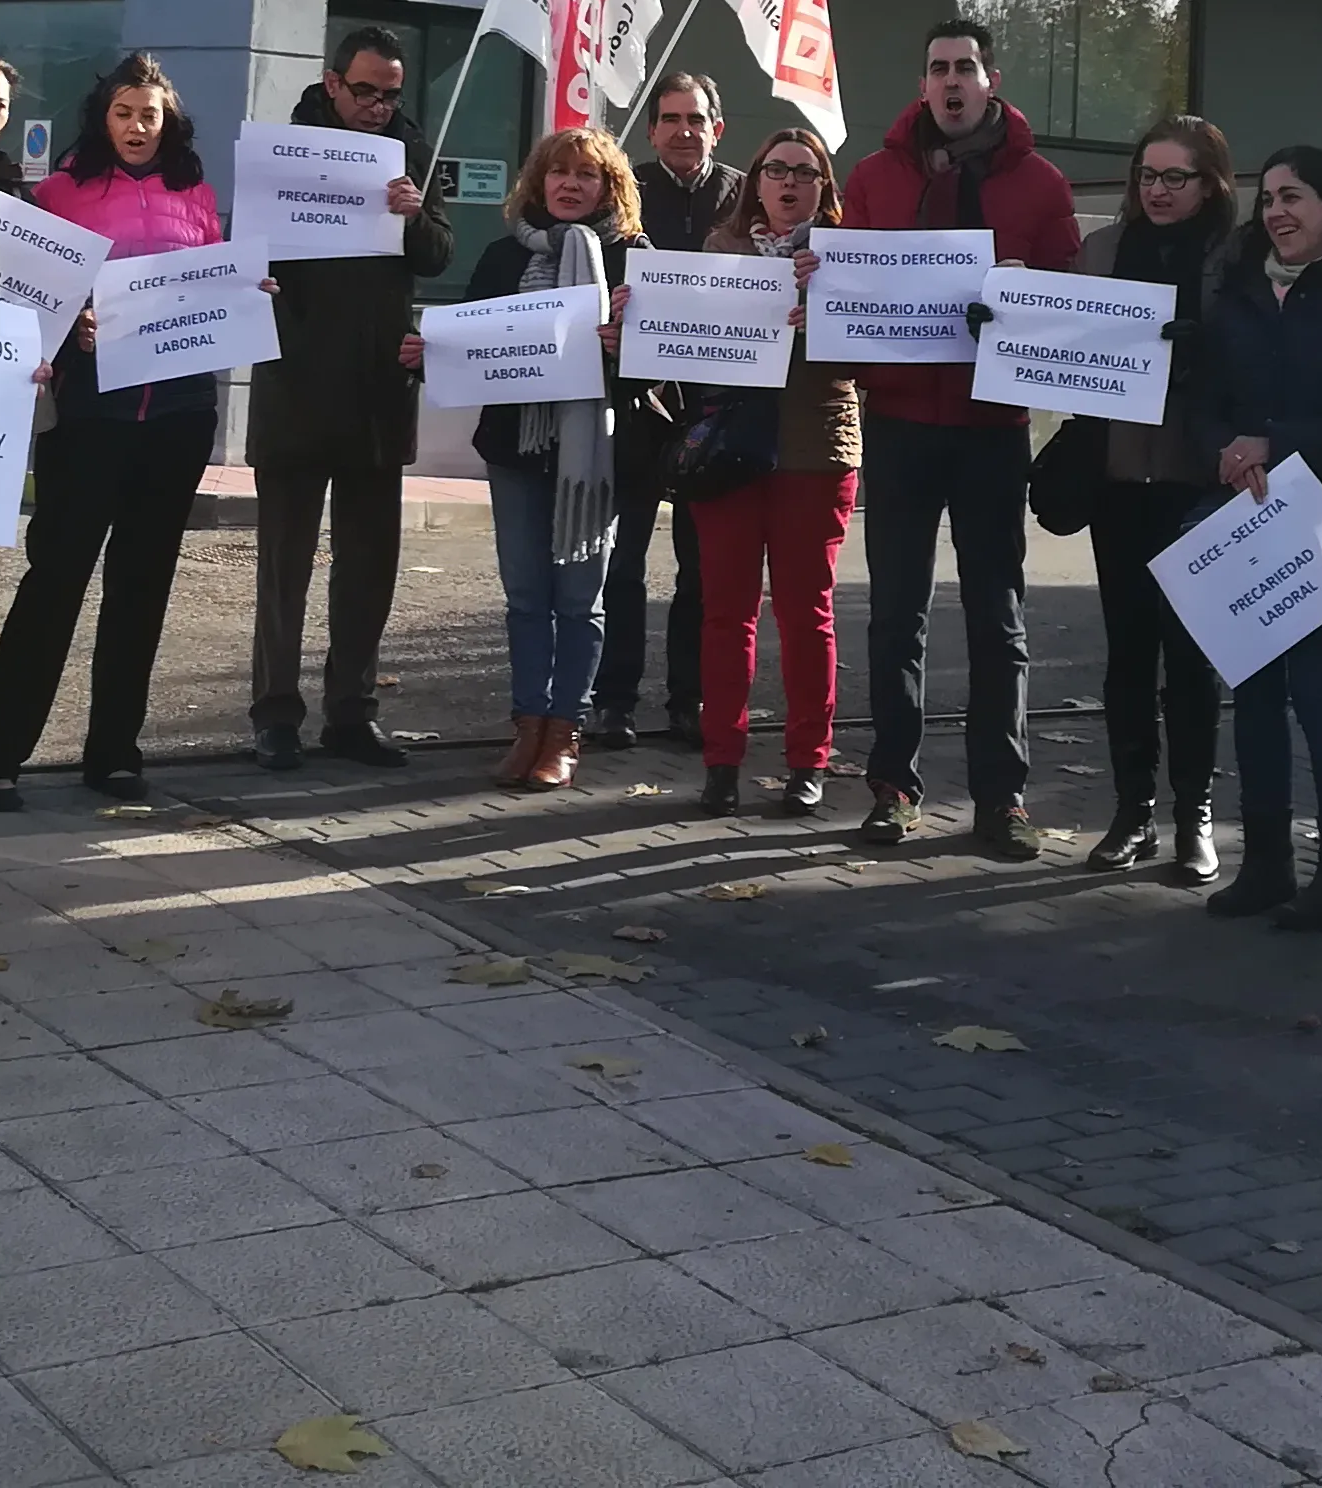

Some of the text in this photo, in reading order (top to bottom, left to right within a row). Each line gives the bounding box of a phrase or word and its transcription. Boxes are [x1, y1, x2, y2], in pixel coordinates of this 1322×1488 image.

[272, 145, 310, 159] CLECE
[323, 148, 378, 163] SELECTIA
[277, 190, 365, 206] PRECARIEDAD
[291, 212, 348, 226] LABORAL
[11, 225, 86, 266] DERECHOS:
[825, 251, 978, 266] NUESTROS DERECHOS:
[129, 276, 167, 292] CLECE
[180, 263, 238, 283] SELECTIA
[641, 271, 782, 292] NUESTROS DERECHOS:
[2, 276, 49, 306] ANUAL
[53, 298, 64, 310] Y
[455, 306, 493, 318] CLECE
[507, 300, 565, 313] SELECTIA
[825, 300, 966, 316] CALENDARIO ANUAL
[999, 290, 1156, 321] NUESTROS DERECHOS:
[138, 308, 227, 336] PRECARIEDAD
[639, 319, 781, 340] CALENDARIO ANUAL Y
[846, 323, 957, 337] PAGA MENSUAL
[155, 334, 216, 355] LABORAL
[467, 342, 558, 360] PRECARIEDAD
[658, 342, 758, 361] PAGA MENSUAL
[996, 340, 1151, 371] CALENDARIO ANUAL Y
[484, 365, 544, 381] LABORAL
[1015, 366, 1126, 393] PAGA MENSUAL
[1187, 543, 1224, 576] CLECE
[1231, 497, 1289, 544] SELECTIA
[1228, 548, 1315, 617] PRECARIEDAD
[1258, 580, 1319, 627] LABORAL
